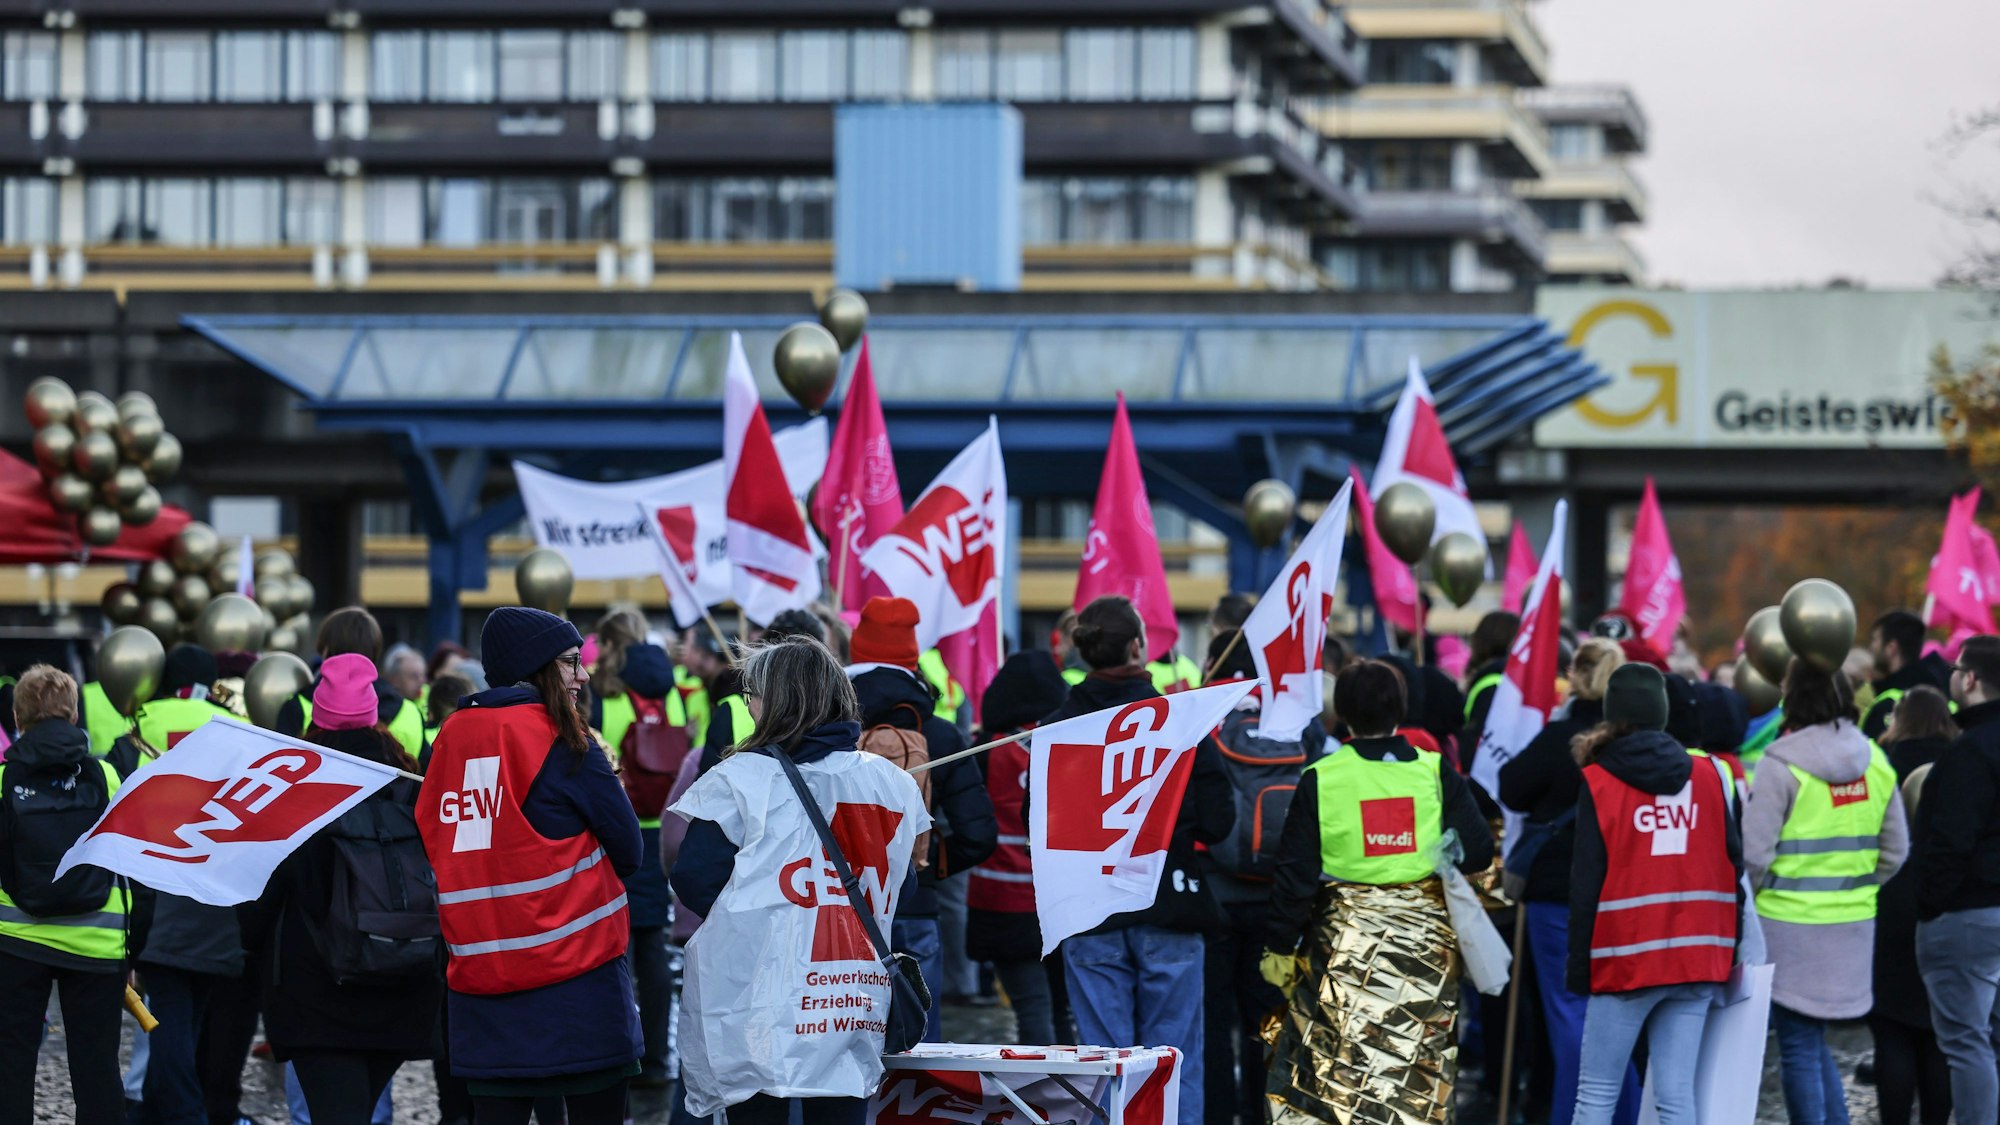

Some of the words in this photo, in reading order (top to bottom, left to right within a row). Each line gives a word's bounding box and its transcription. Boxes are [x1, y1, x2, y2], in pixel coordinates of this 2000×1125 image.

[439, 785, 503, 824] GEW
[1633, 803, 1698, 833] GEW
[1366, 831, 1413, 847] ver.di
[778, 856, 893, 915] GEW
[801, 994, 873, 1012] Erziehung
[795, 1018, 828, 1035] und
